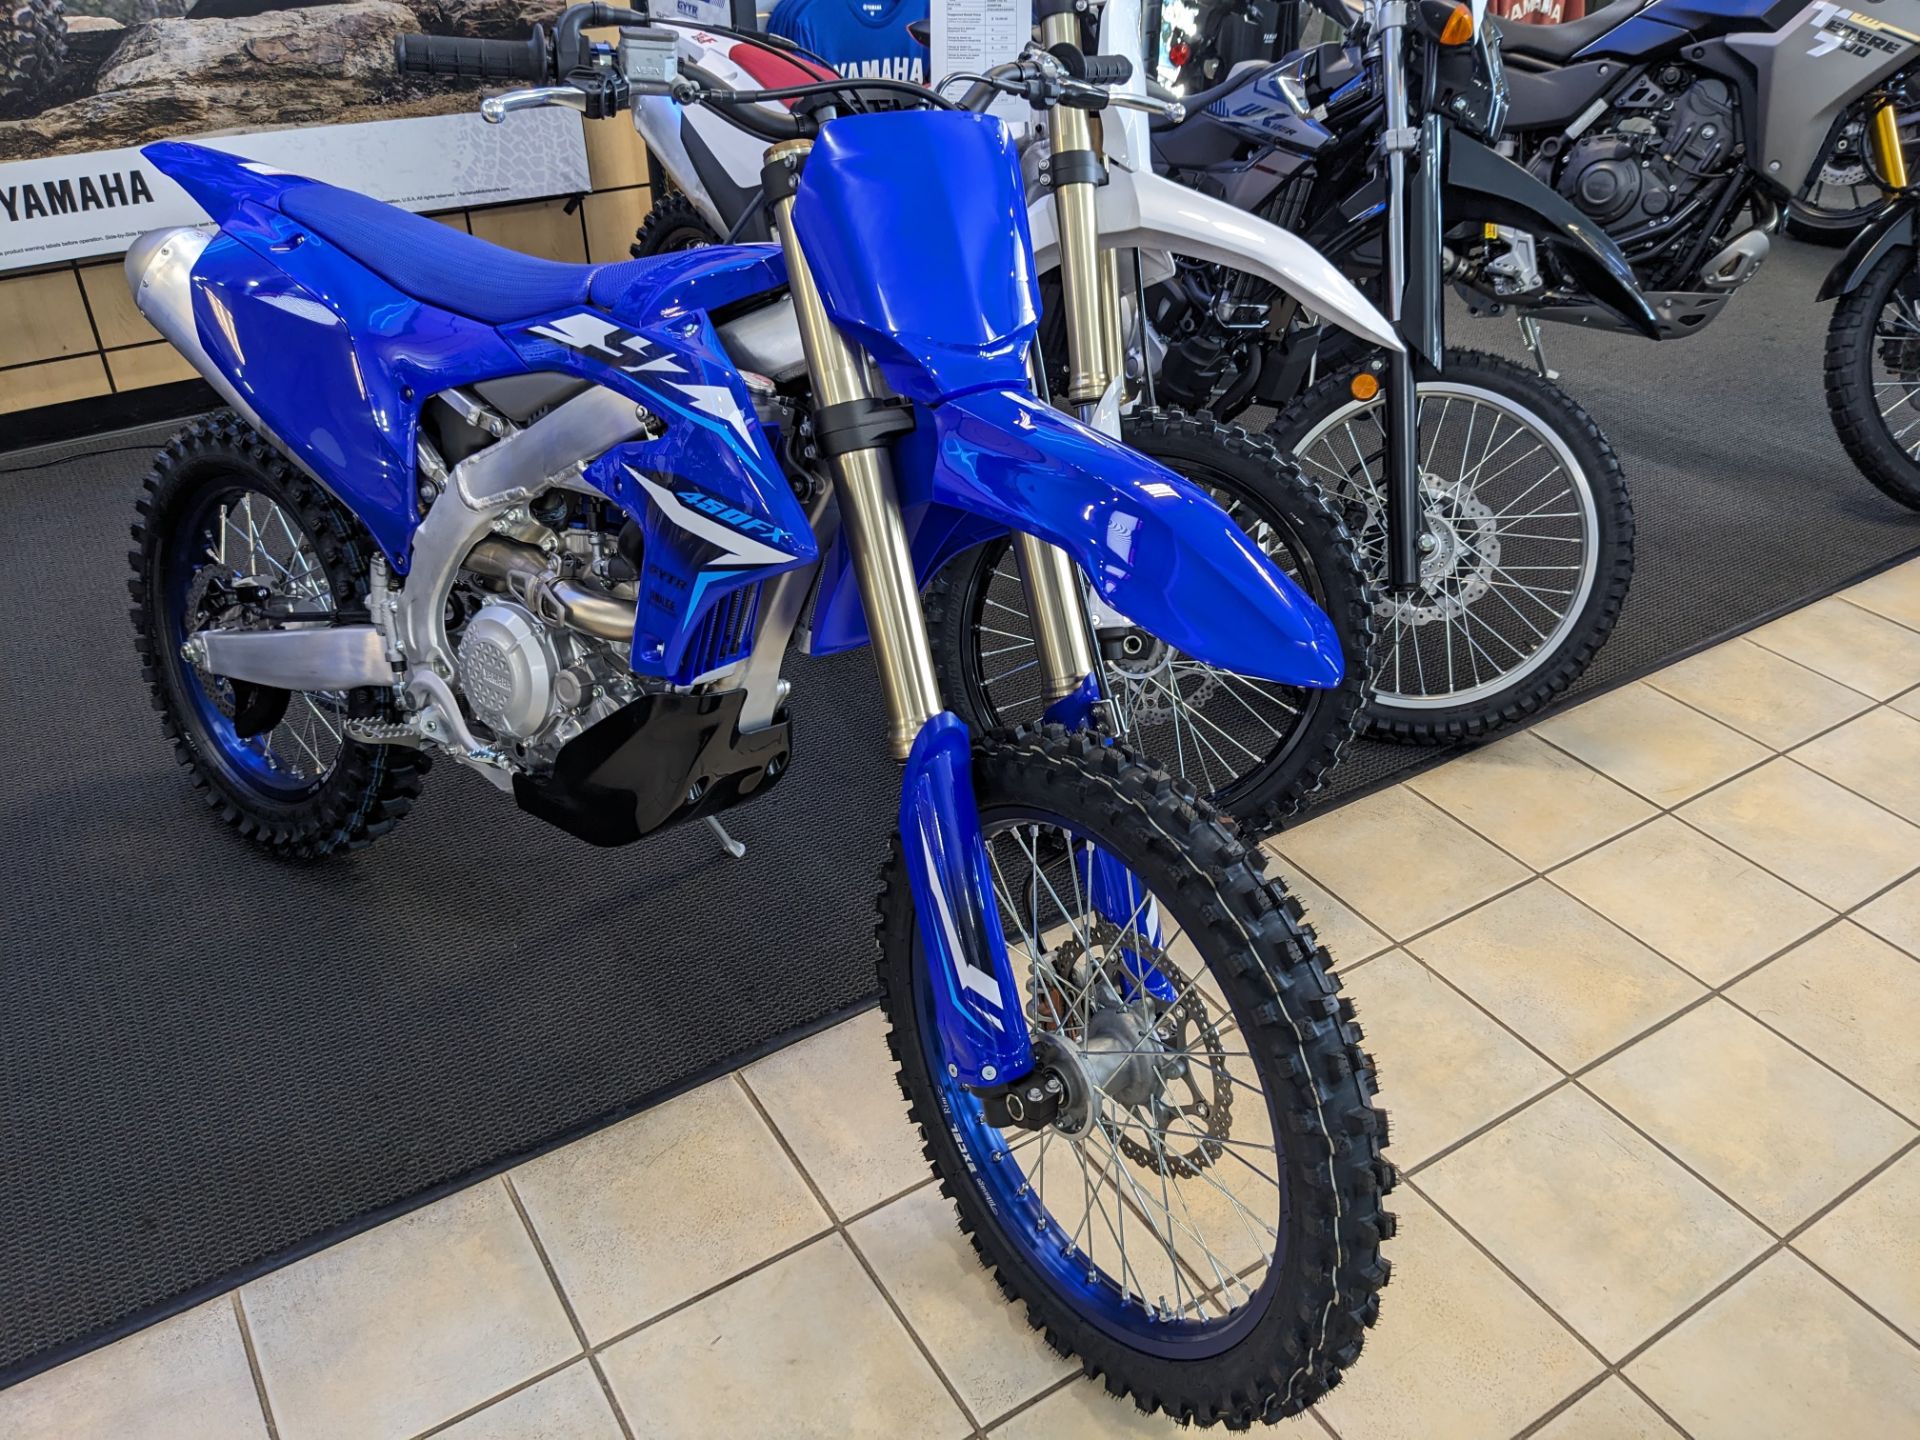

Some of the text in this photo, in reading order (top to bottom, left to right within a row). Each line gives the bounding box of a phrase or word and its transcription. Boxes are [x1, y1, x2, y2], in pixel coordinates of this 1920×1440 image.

[1504, 0, 1561, 24] AMAHA
[833, 56, 924, 85] YAMAHA
[0, 169, 154, 222] YAMAHA
[676, 491, 794, 543] 450FX
[951, 1123, 977, 1173] EXCEL
